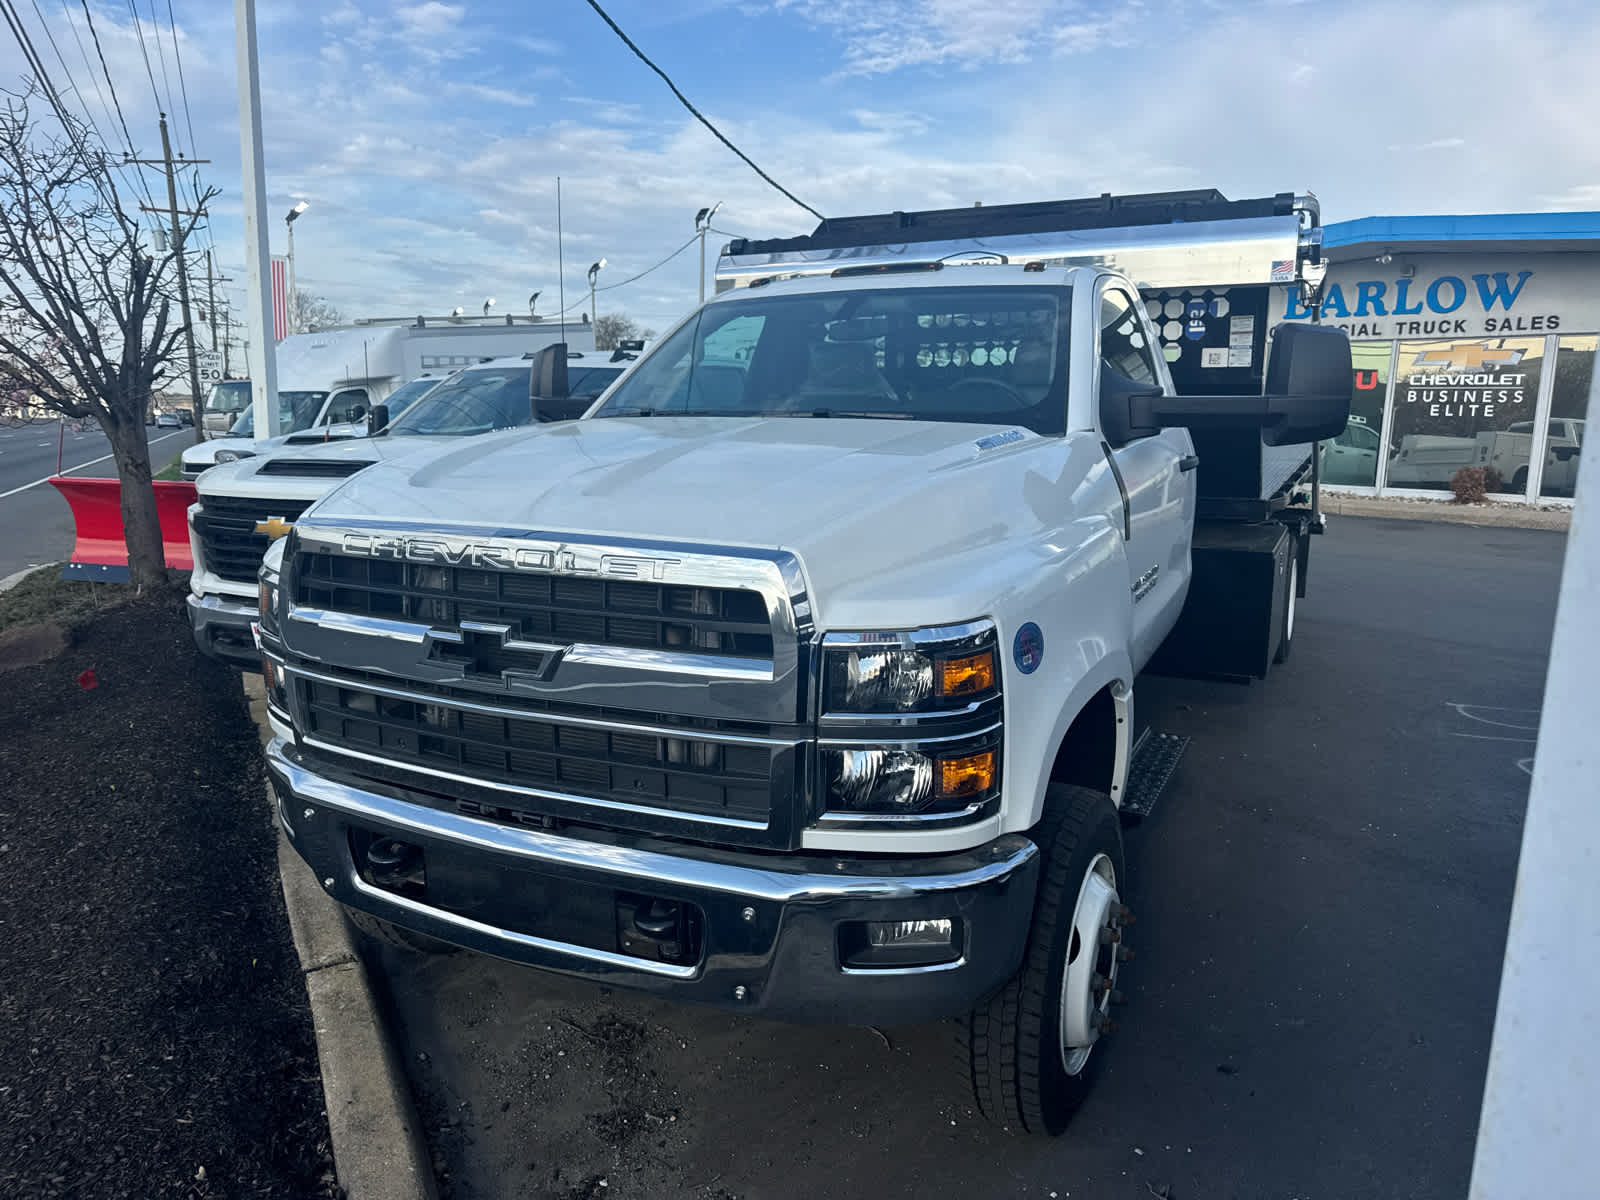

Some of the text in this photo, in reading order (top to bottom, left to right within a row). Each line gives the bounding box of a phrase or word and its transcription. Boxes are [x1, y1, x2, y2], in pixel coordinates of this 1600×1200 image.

[1283, 271, 1533, 319] BARLOW
[1396, 319, 1467, 335] TRUCK
[1484, 315, 1560, 332] SALES
[201, 369, 220, 380] 50
[1409, 374, 1526, 386] CHEVROLET
[1407, 390, 1524, 403] BUSINESS
[1430, 404, 1495, 417] ELITE
[343, 533, 682, 580] CHEVROLET
